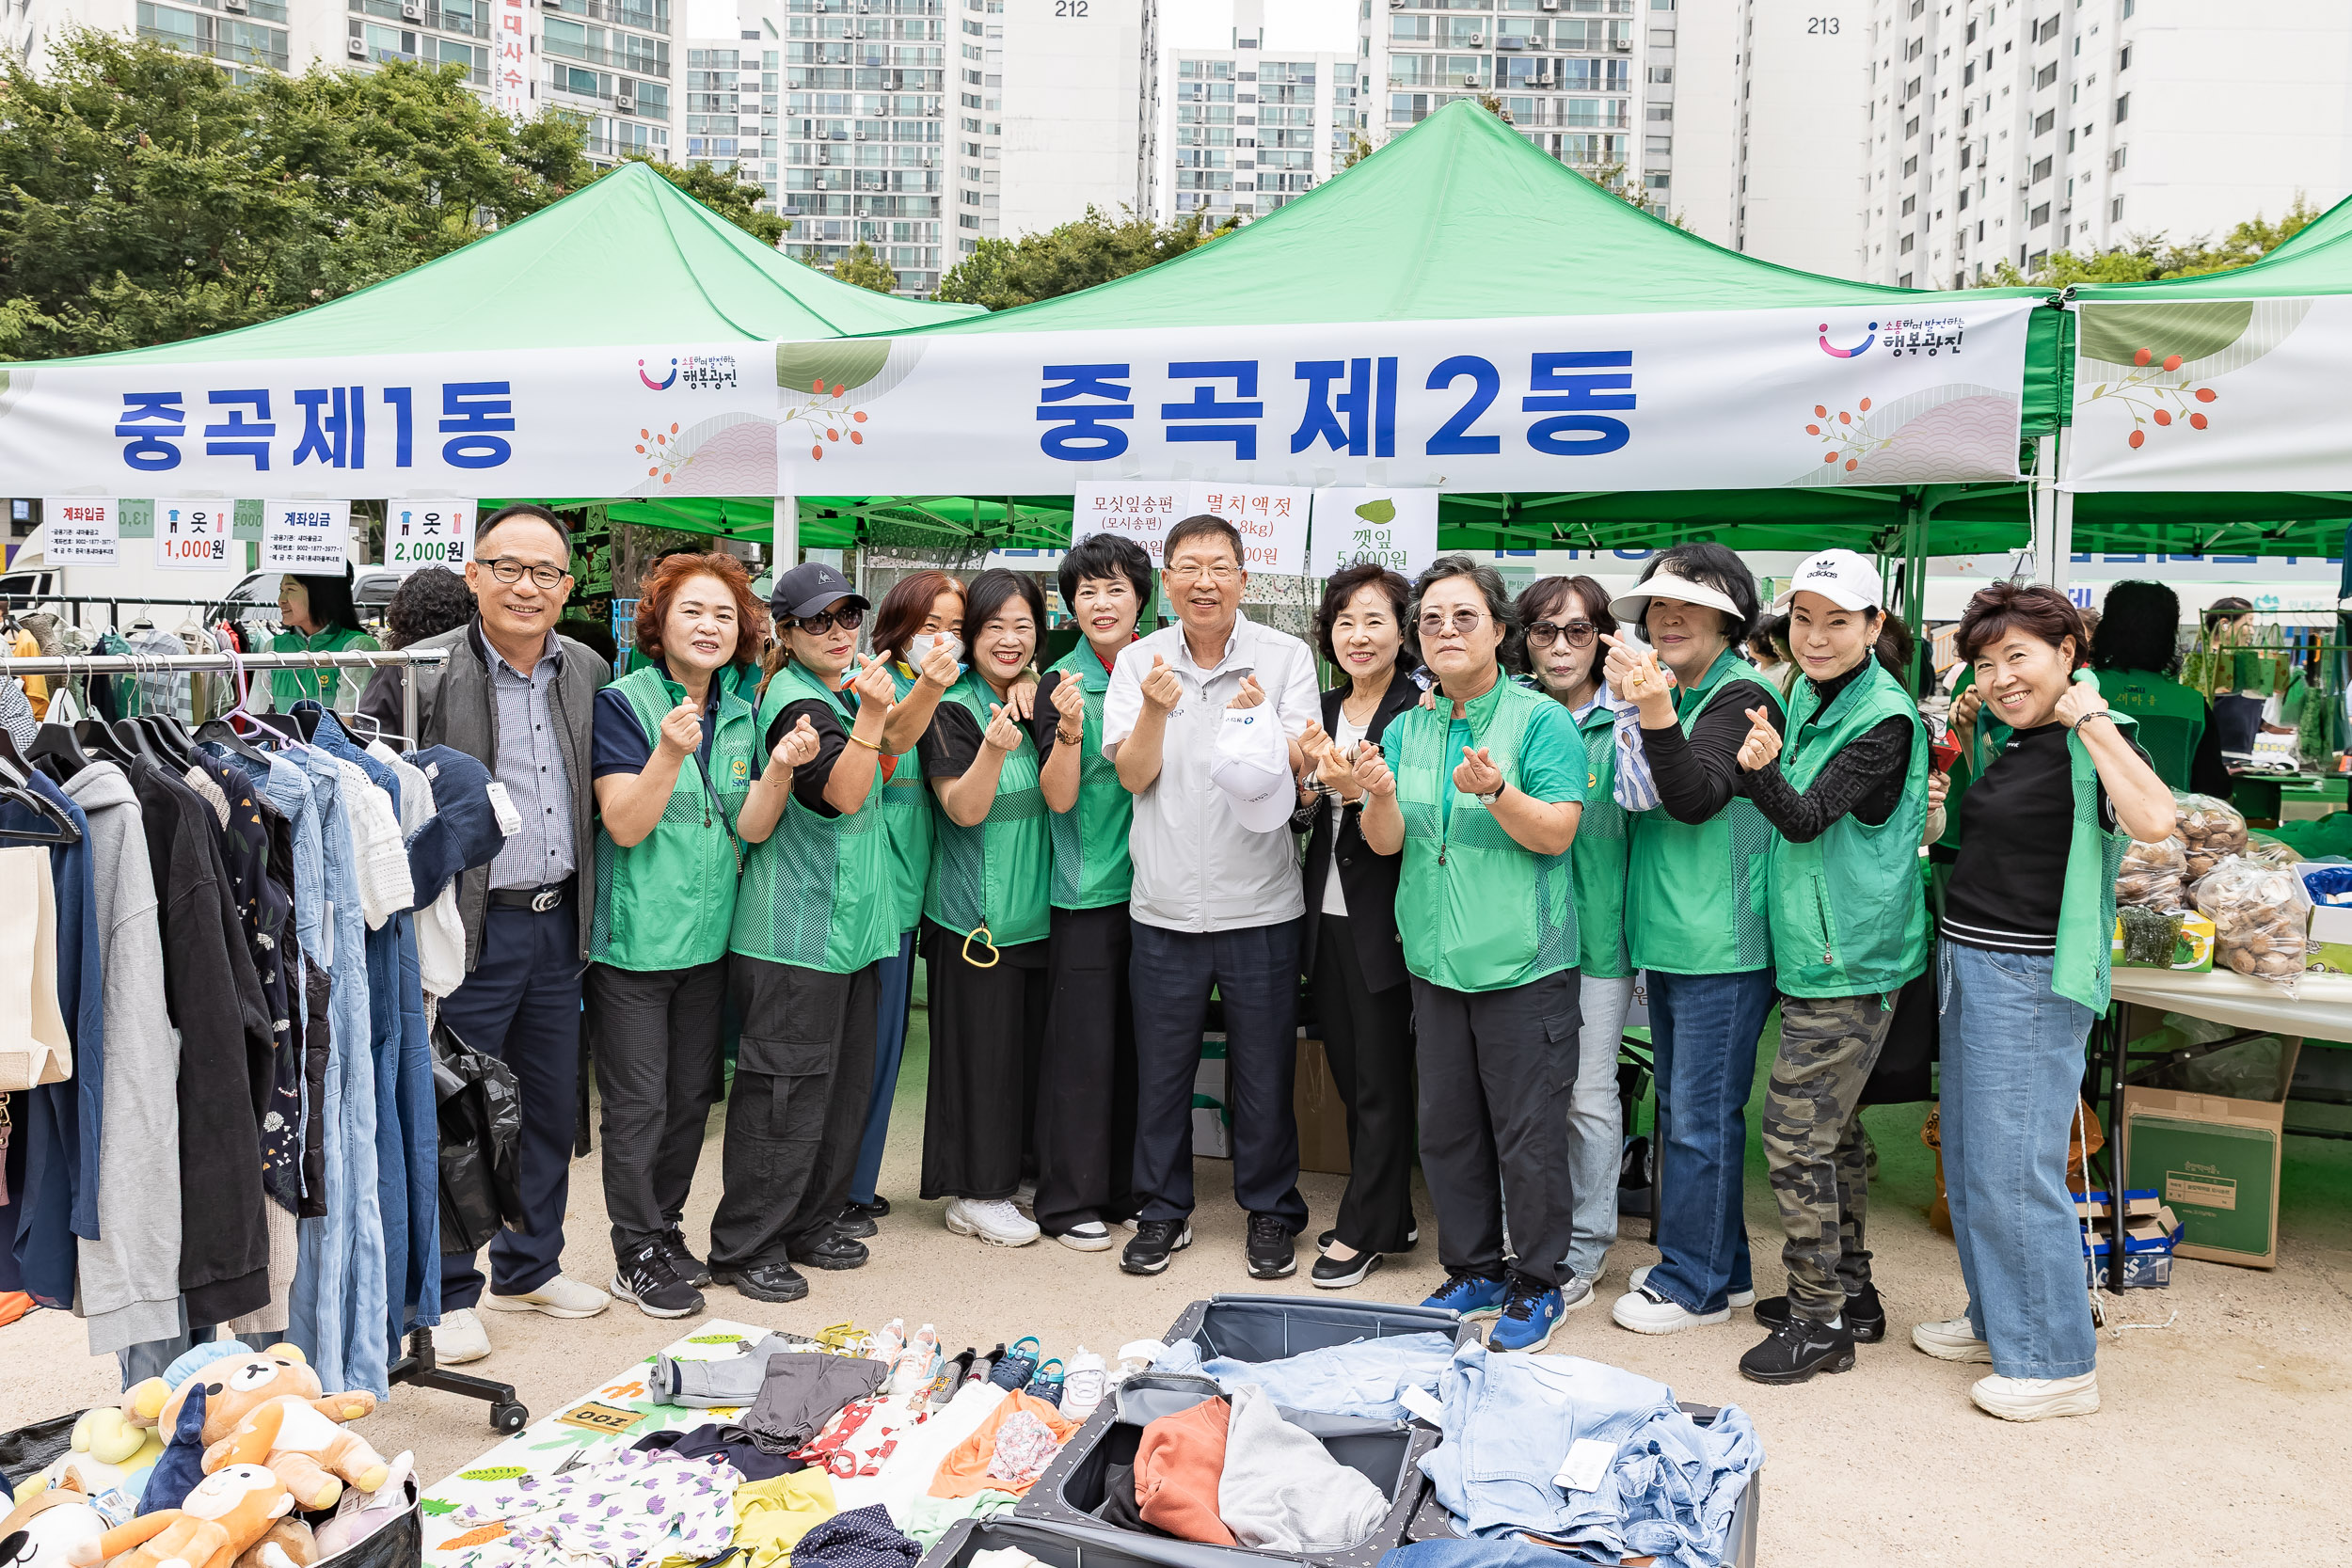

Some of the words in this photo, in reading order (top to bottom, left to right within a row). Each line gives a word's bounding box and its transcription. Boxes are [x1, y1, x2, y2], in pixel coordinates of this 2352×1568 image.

[1055, 0, 1089, 17] 212
[1807, 17, 1839, 35] 213
[503, 0, 523, 111] 대사수!!
[1883, 318, 1923, 335] 소통하며
[1924, 317, 1965, 332] 발전하는
[1883, 331, 1963, 357] 행복광진
[681, 356, 707, 370] 소통하며
[708, 356, 736, 369] 발전하는
[682, 368, 737, 390] 행복광진
[1036, 351, 1637, 461] 중곡제2동
[115, 381, 516, 471] 중곡제1동
[63, 507, 105, 521] 계좌입금
[1091, 495, 1173, 514] 모싯잎송편
[1207, 493, 1291, 517] 멸치액젓
[190, 512, 208, 534] 옷
[284, 512, 331, 527] 계좌입금
[422, 513, 441, 535] 옷
[1102, 516, 1163, 531] (모시송편)
[1352, 529, 1391, 549] 깻잎
[165, 539, 226, 561] 1,000원
[394, 541, 465, 562] 2,000원
[1806, 570, 1837, 578] adidas
[2114, 692, 2157, 706] 새마을
